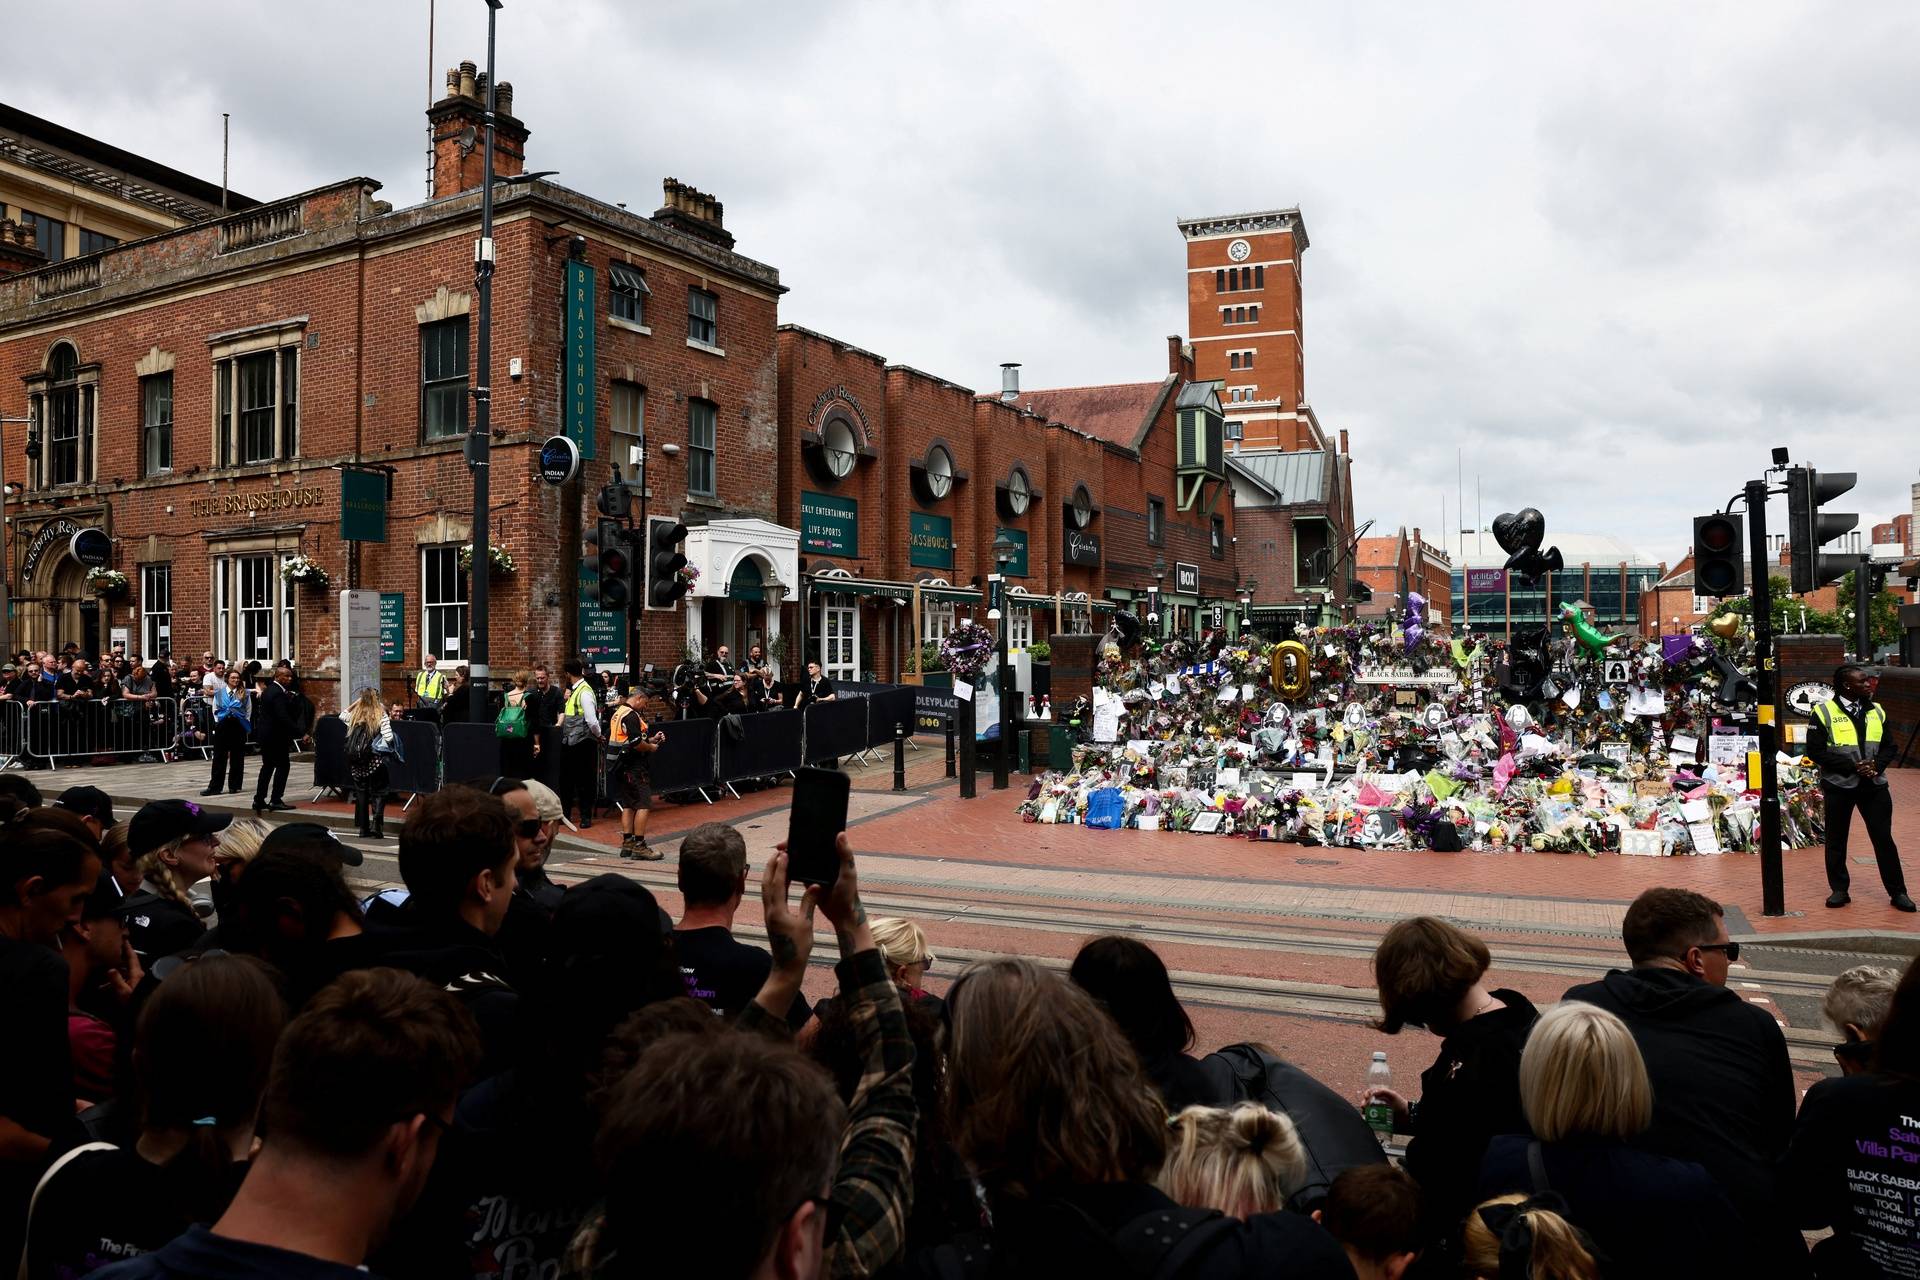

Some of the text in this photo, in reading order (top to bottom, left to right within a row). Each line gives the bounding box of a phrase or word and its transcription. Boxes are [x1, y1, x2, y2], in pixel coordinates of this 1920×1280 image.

[576, 269, 585, 453] BRASSHOUSE
[191, 487, 324, 517] THE BRASSHOUSE
[802, 504, 854, 520] EKLY ENTERTAINMENT
[808, 524, 842, 537] LIVE SPORTS
[910, 533, 949, 550] RASSHOUSE
[1069, 531, 1097, 560] Celebrity
[22, 526, 55, 581] Celebrity
[1180, 570, 1195, 586] BOX
[916, 695, 959, 708] DLEYPLACE
[1369, 1108, 1379, 1119] G
[1855, 1138, 1888, 1158] Villa
[1847, 1168, 1880, 1183] BLACK
[1849, 1182, 1904, 1201] METALLICA
[1873, 1198, 1904, 1215] TOOL
[1867, 1217, 1908, 1237] ANTHRAX
[1879, 1210, 1915, 1228] CHAINS
[100, 1237, 121, 1254] The
